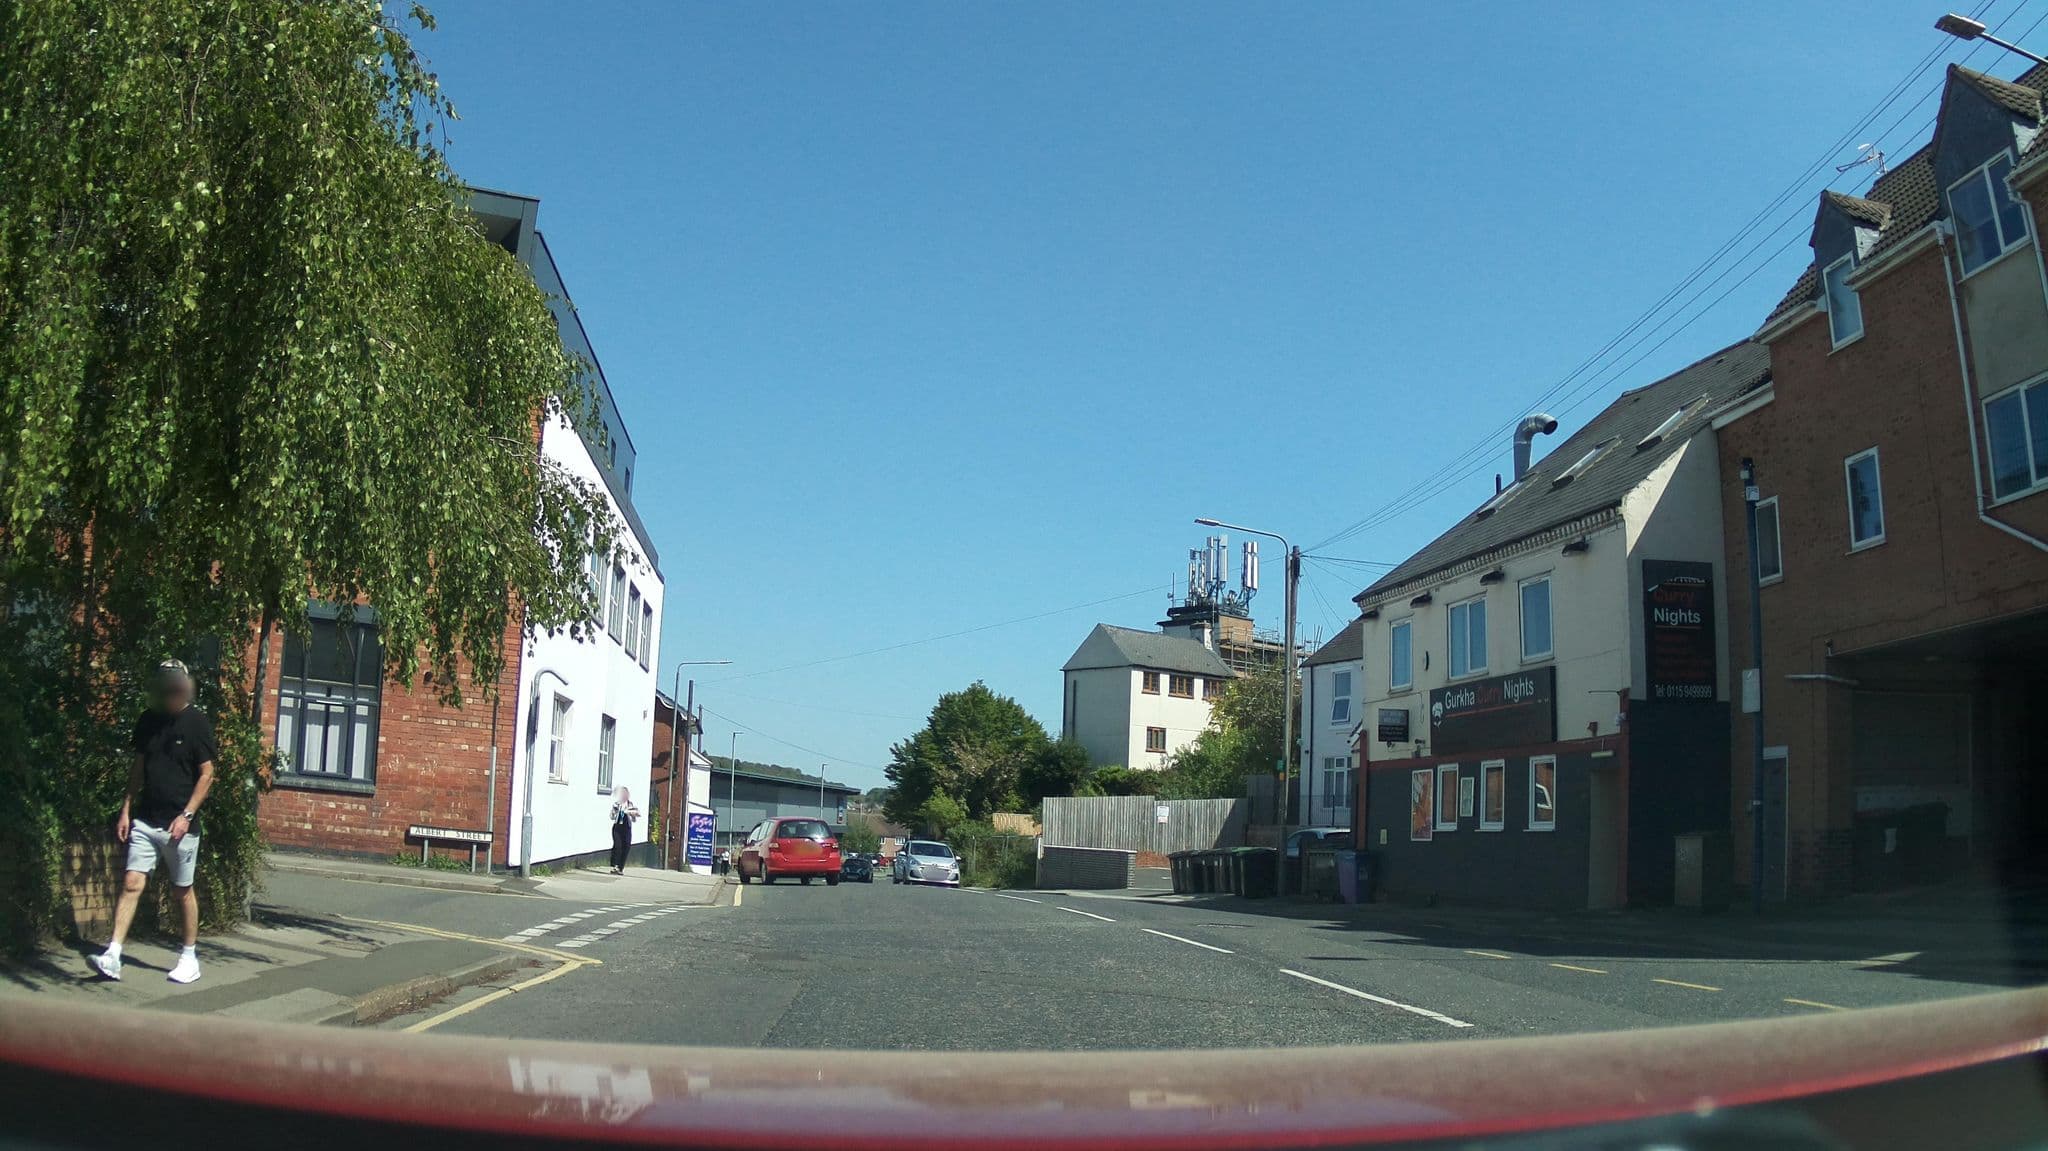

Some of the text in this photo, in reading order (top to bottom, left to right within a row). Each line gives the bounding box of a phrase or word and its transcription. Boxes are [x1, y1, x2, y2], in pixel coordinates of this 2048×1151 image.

[1654, 607, 1702, 625] Nights
[1445, 688, 1475, 709] Gurkha
[1503, 676, 1535, 703] Nights
[1666, 684, 1683, 698] 0115
[415, 828, 486, 841] ALBERT STREET
